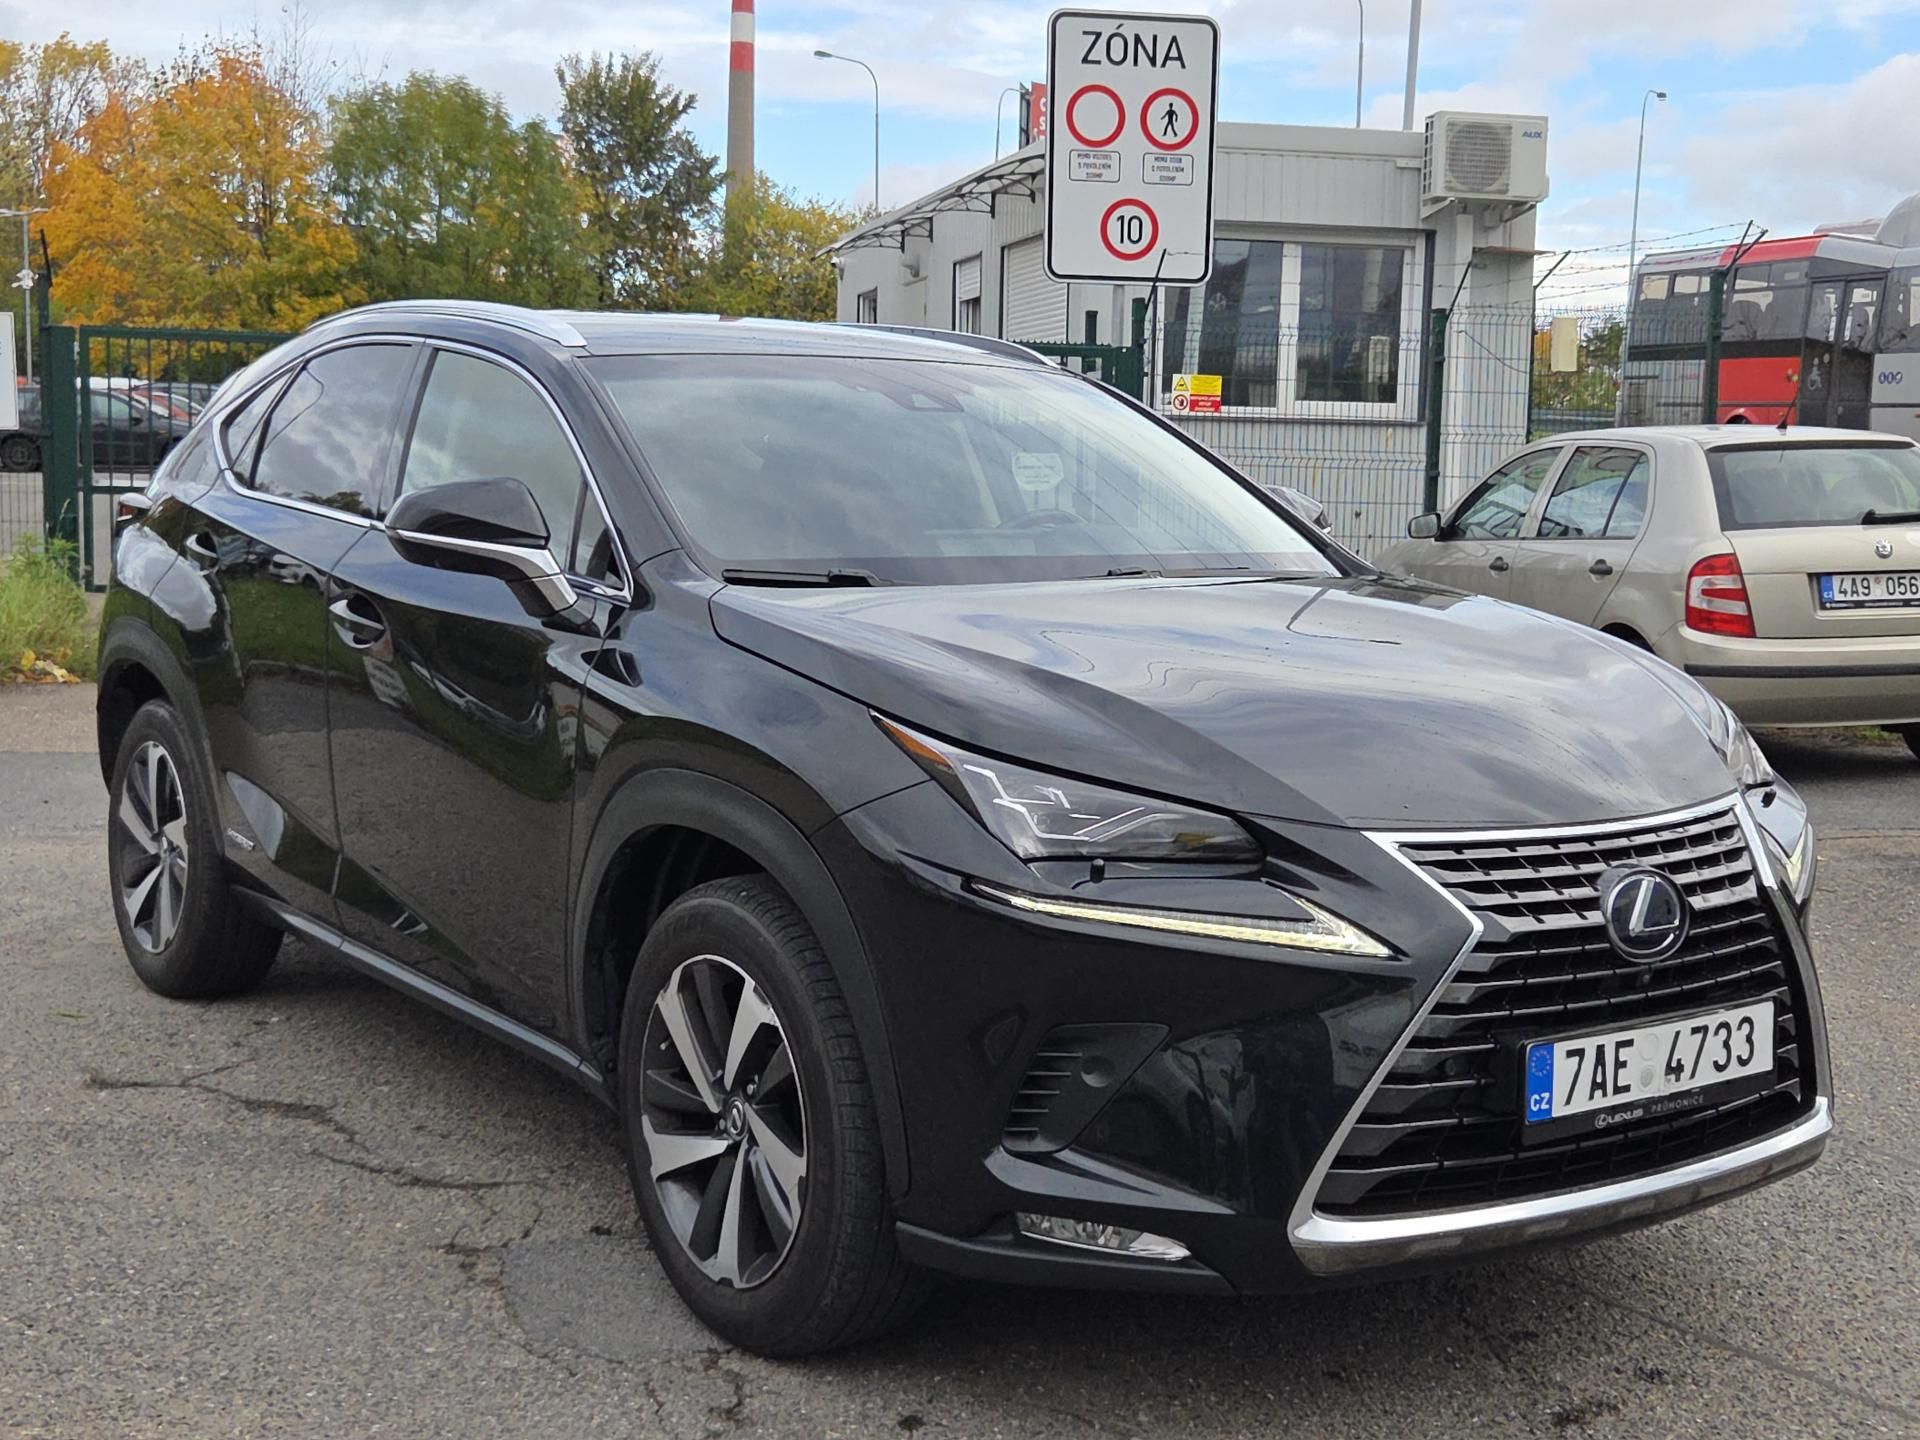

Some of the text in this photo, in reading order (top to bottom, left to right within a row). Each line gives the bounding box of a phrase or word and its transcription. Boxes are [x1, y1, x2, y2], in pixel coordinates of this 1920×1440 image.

[1081, 24, 1186, 69] ZÓNA
[1116, 215, 1143, 244] 10
[1878, 371, 1904, 384] 009
[1838, 576, 1871, 598] 4A9
[1563, 1015, 1755, 1107] 7AE 4733
[1529, 1092, 1550, 1112] CZ
